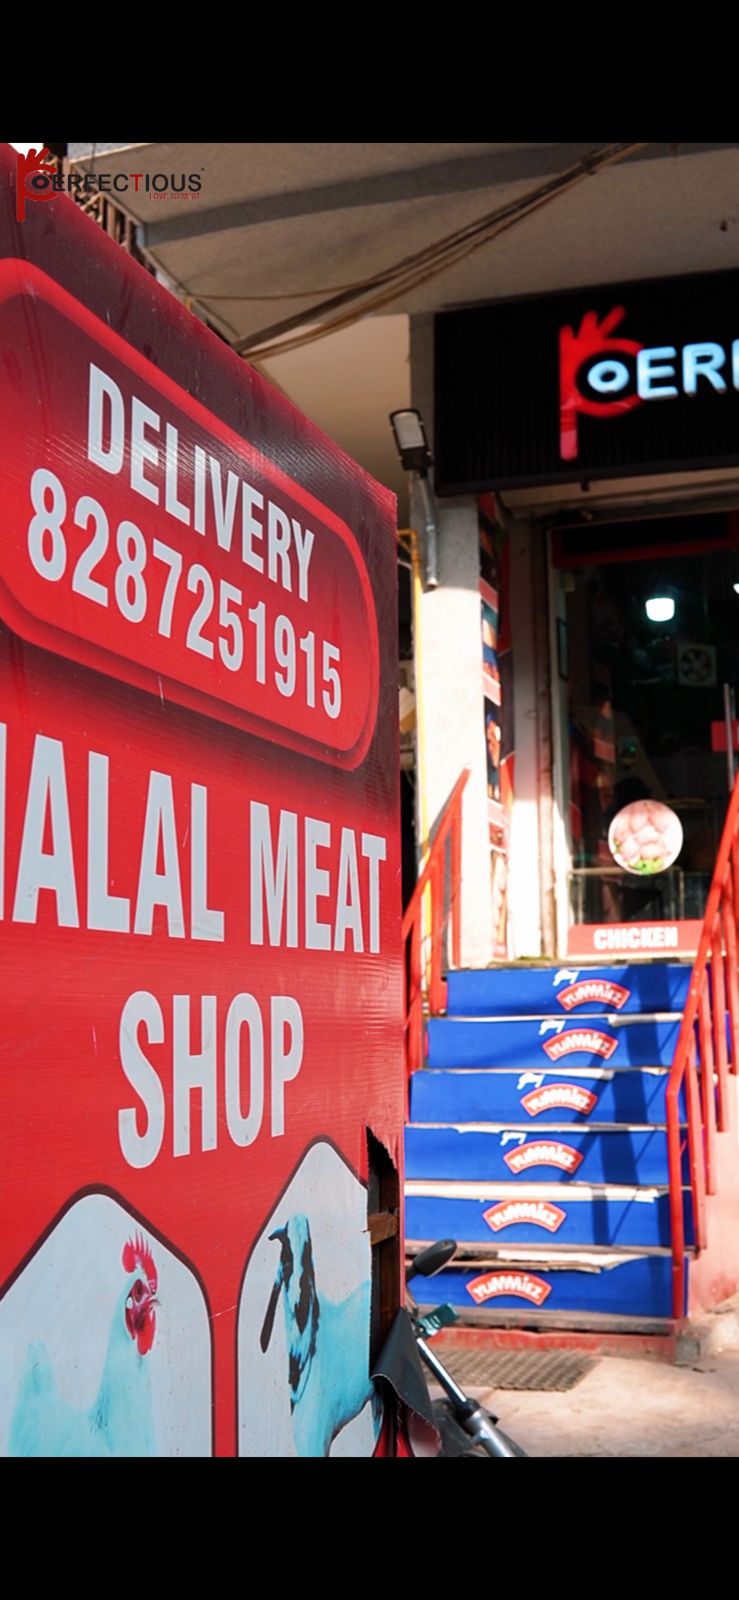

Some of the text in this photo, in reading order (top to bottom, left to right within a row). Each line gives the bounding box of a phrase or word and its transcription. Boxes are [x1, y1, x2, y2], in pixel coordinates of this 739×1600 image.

[27, 467, 342, 720] 8287251915
[88, 362, 315, 602] DELIVERY
[0, 722, 387, 954] ALAL MEAT
[593, 926, 678, 950] CHICKEN
[118, 990, 304, 1169] SHOP
